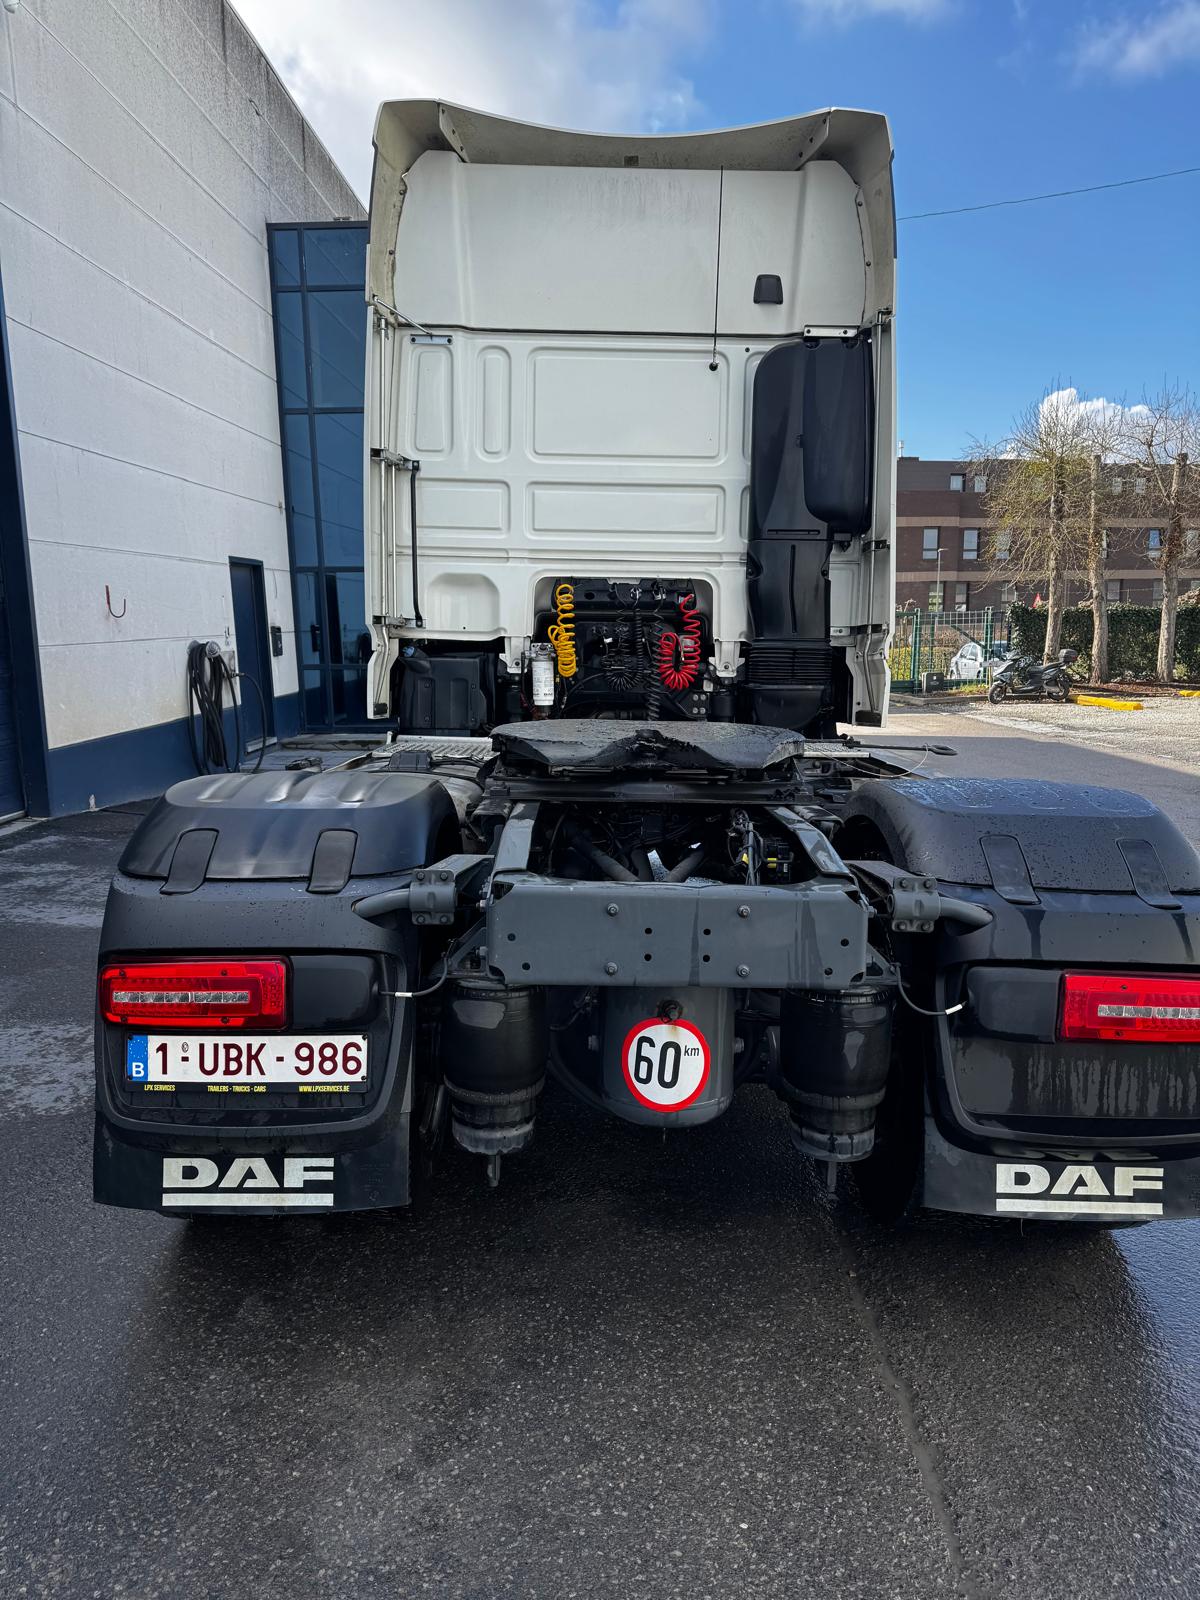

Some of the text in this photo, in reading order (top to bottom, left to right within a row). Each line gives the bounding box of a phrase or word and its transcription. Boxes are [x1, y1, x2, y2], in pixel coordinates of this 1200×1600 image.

[132, 1062, 145, 1077] B
[634, 1036, 700, 1089] 60 km
[163, 1158, 334, 1188] DAF
[996, 1163, 1164, 1197] DAF
